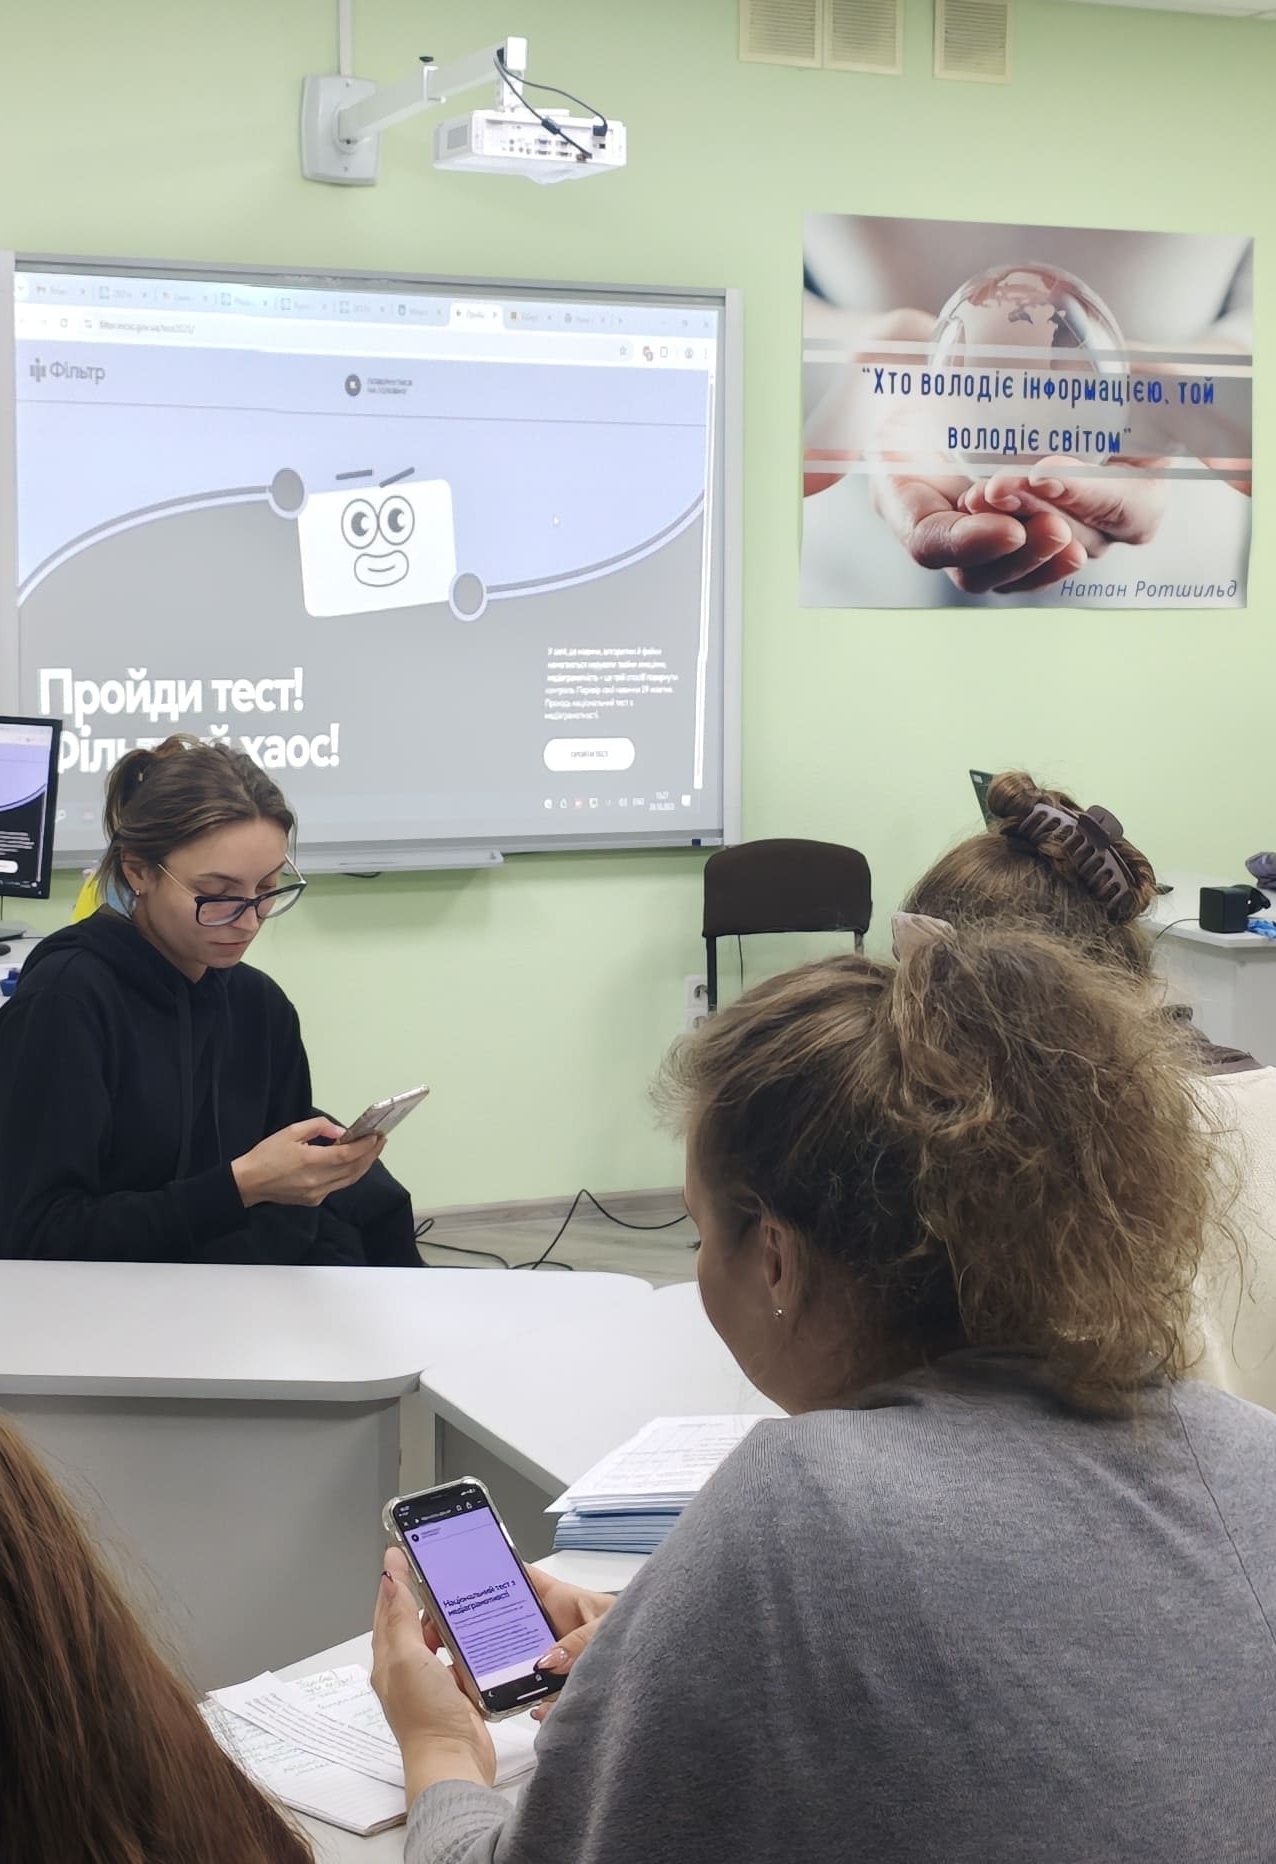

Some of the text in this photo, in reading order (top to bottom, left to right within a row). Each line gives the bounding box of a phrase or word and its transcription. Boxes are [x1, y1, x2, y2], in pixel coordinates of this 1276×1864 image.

[50, 361, 106, 384] Фільтр
[921, 371, 1014, 402] володіє
[1177, 376, 1214, 404] той
[947, 424, 1040, 456] володіє
[1059, 579, 1237, 598] Натан Ротшильд
[39, 666, 305, 729] Пройди тест!
[238, 722, 341, 768] хаос!
